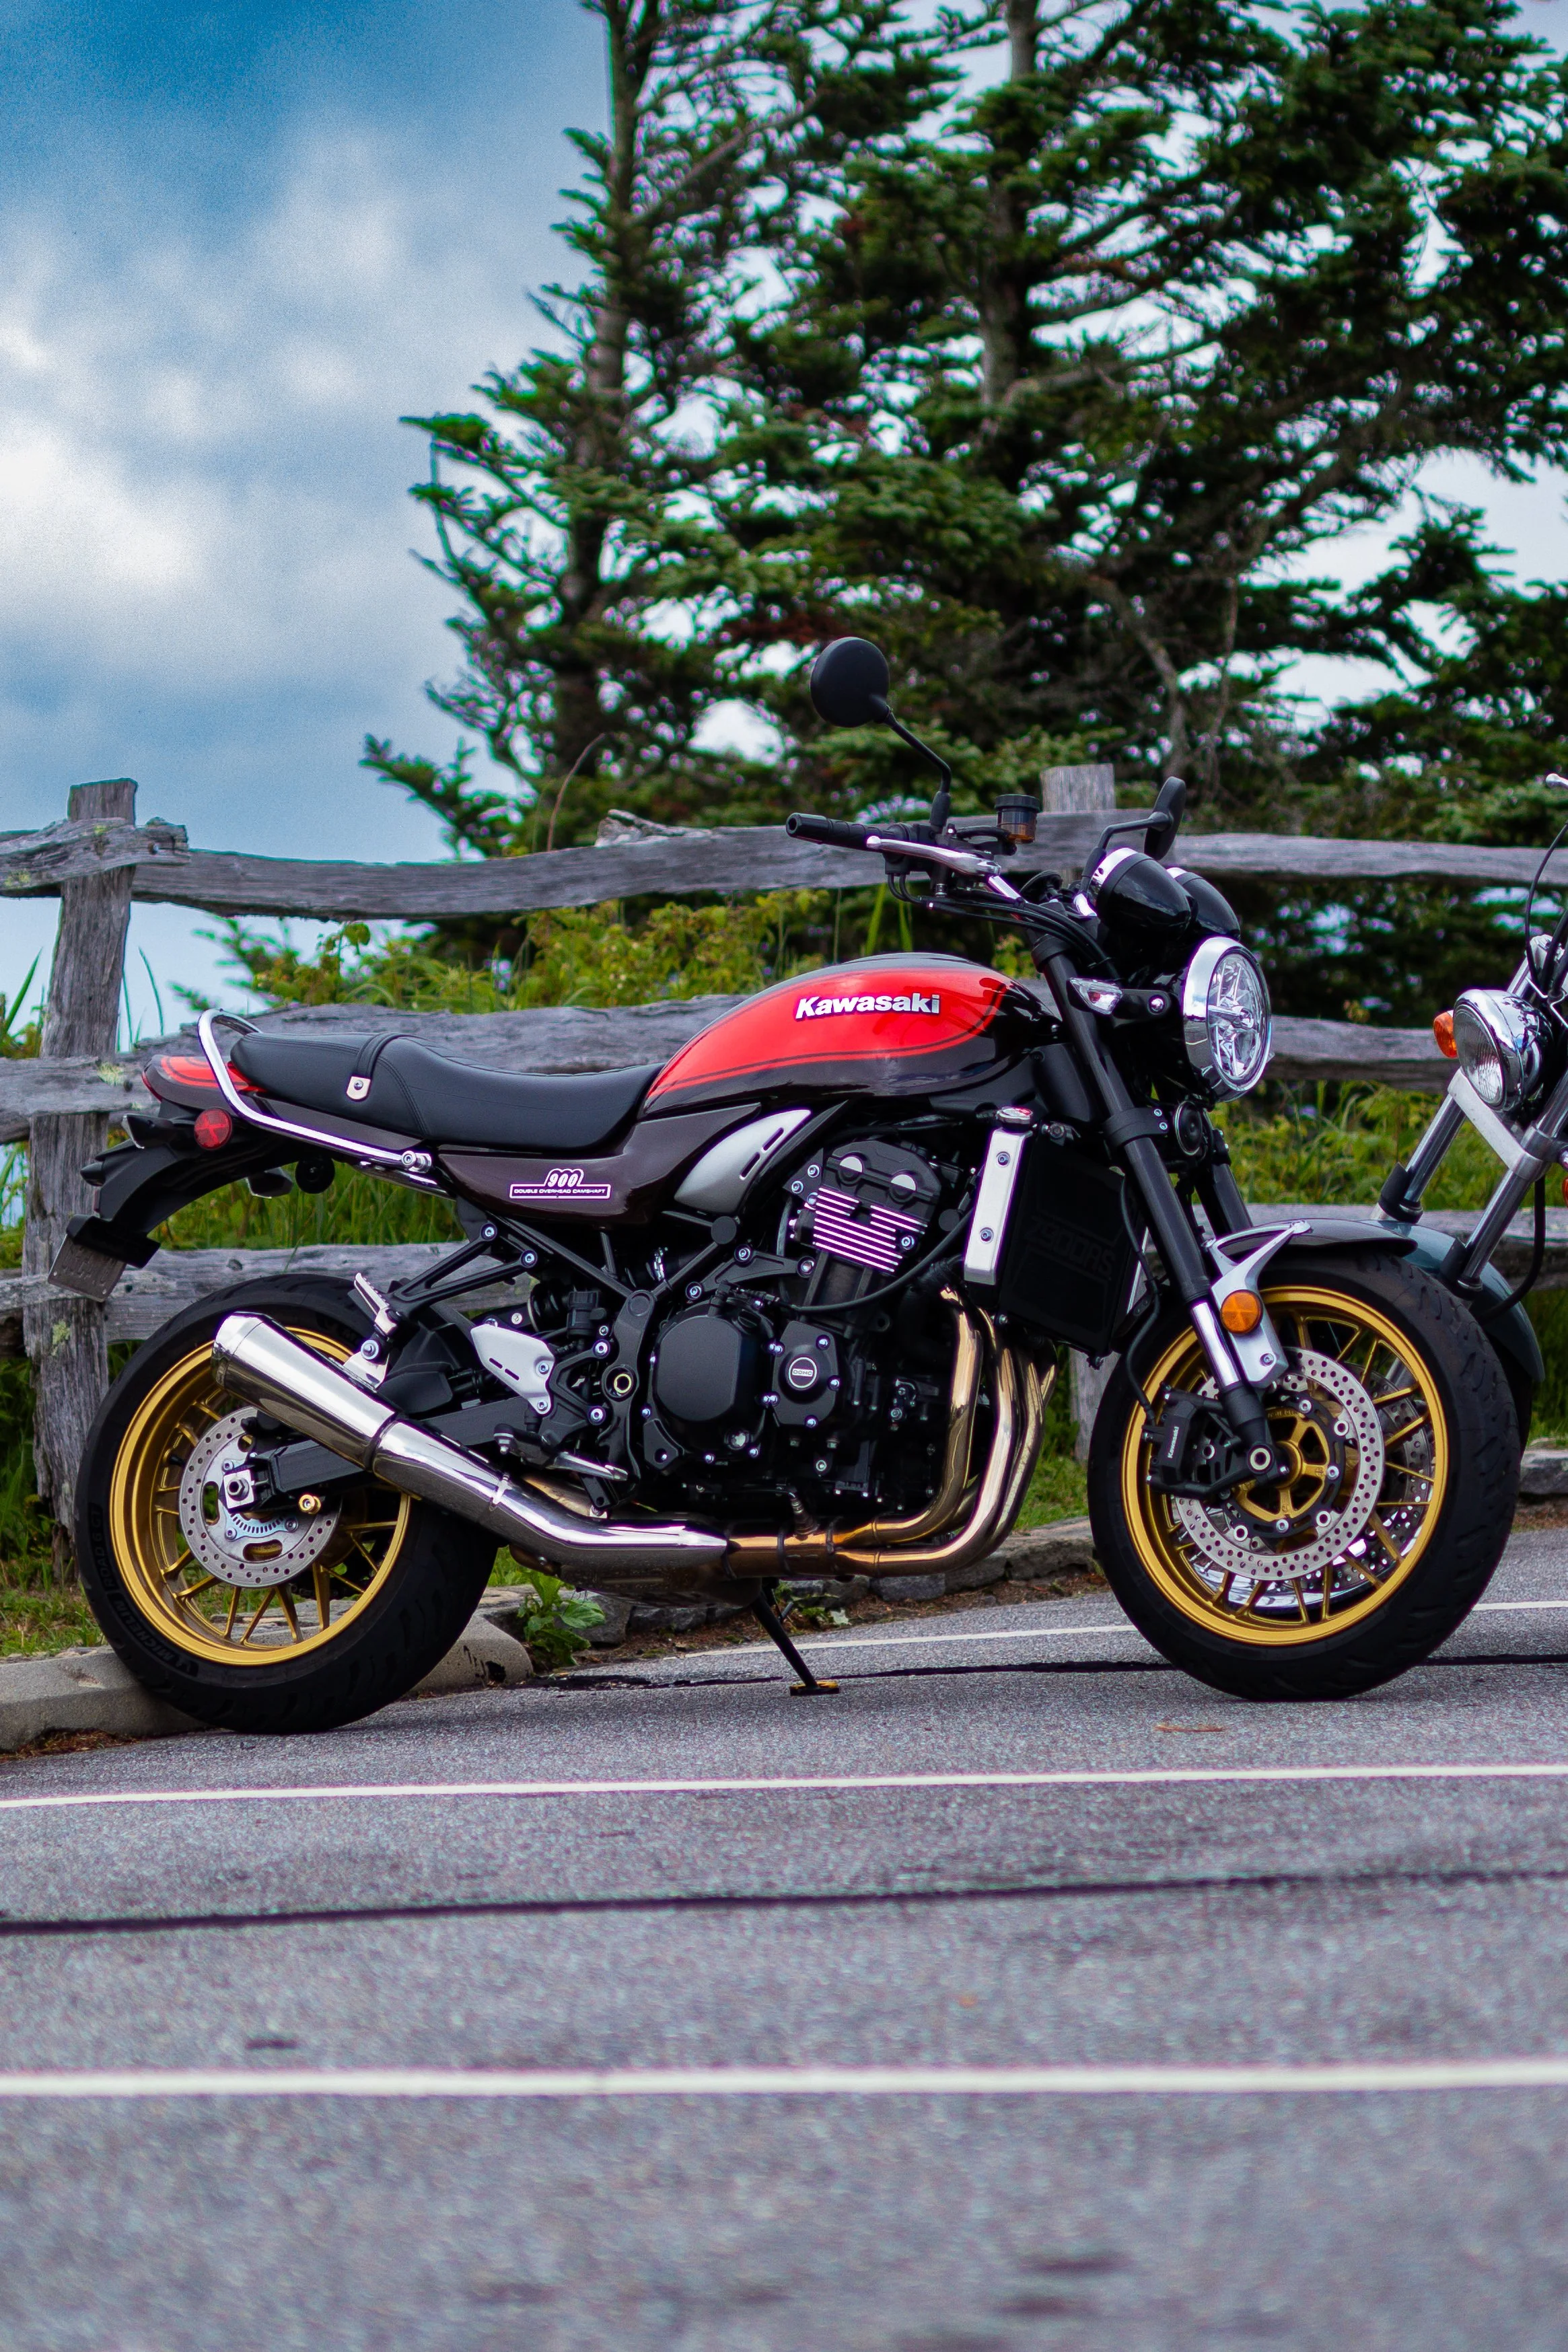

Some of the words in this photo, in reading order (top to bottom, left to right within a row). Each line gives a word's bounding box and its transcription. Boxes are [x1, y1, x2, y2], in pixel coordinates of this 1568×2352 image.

[795, 993, 941, 1020] Kawasaki
[548, 1173, 579, 1187] 900
[1167, 1426, 1180, 1458] Kawasaki
[90, 1507, 102, 1528] GT
[92, 1532, 103, 1542] 6
[94, 1546, 116, 1587] ROAD
[113, 1599, 174, 1661] MICHELIN
